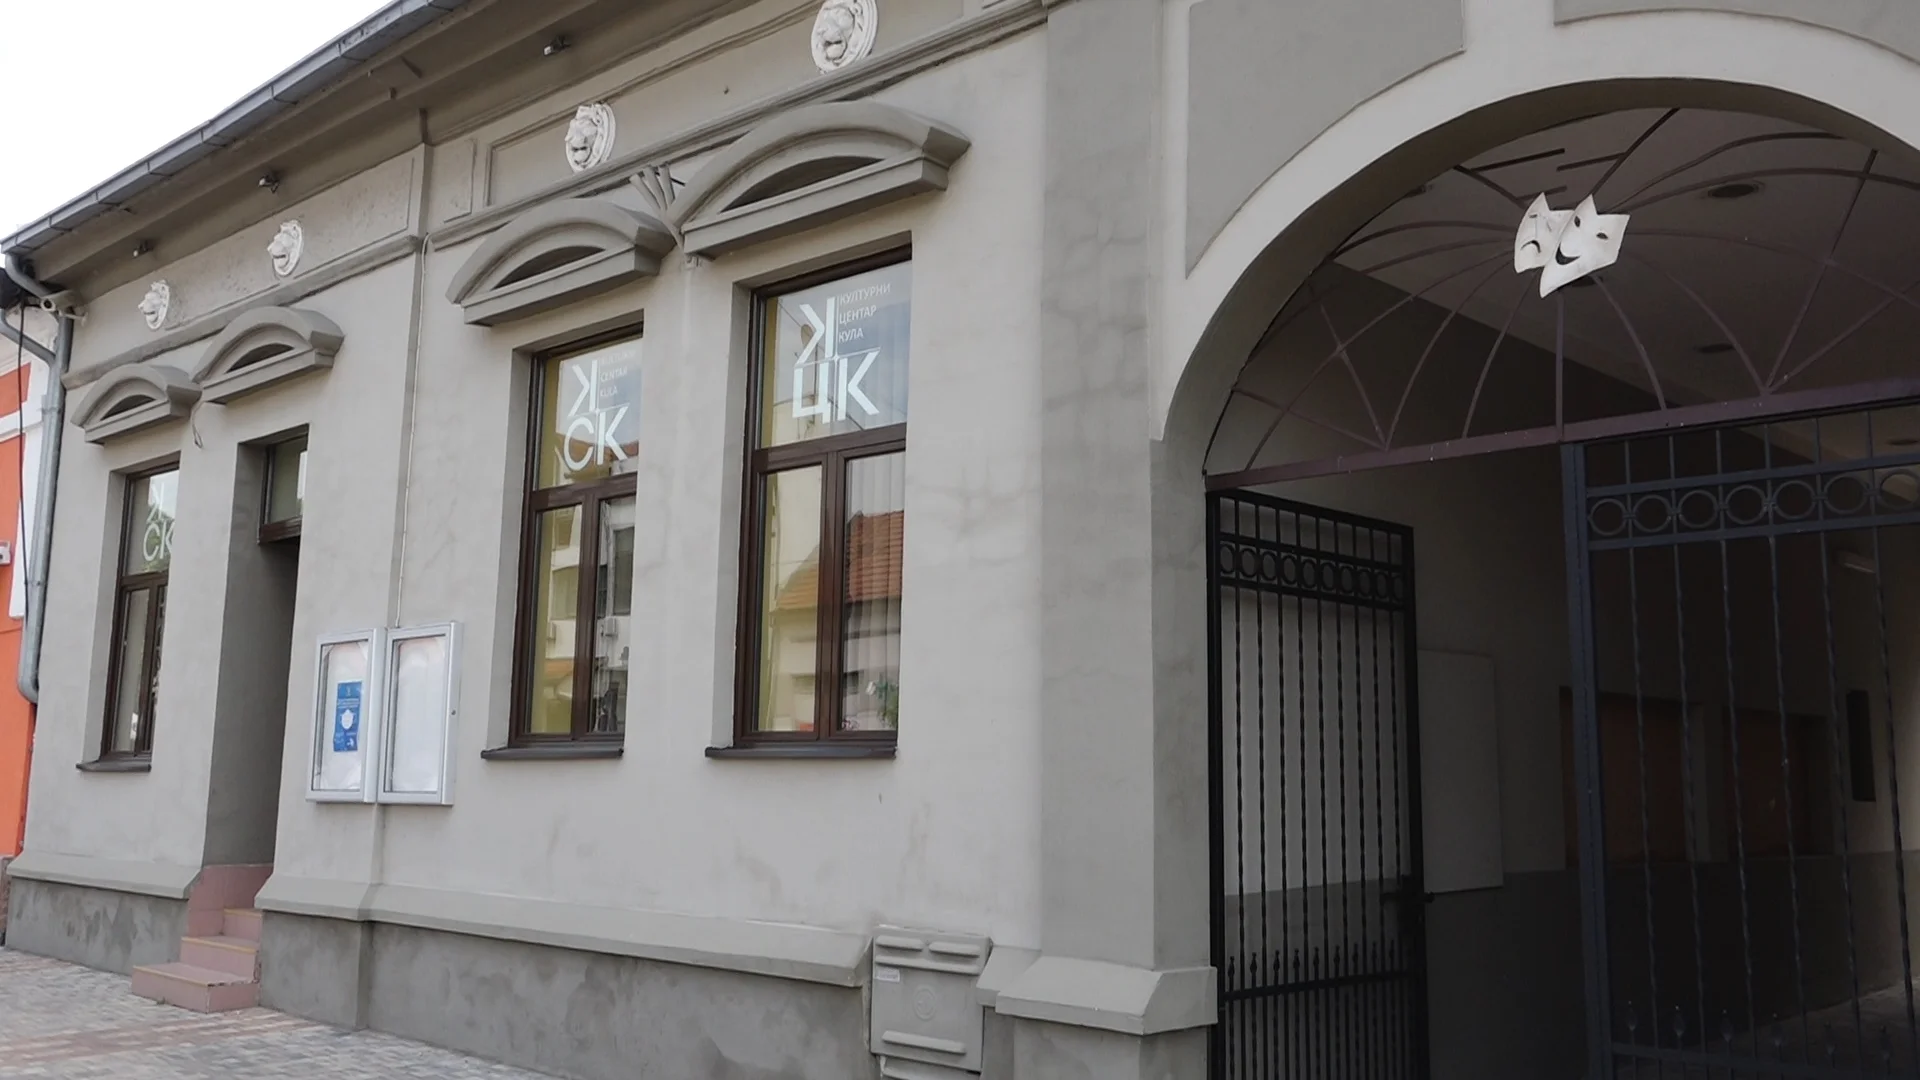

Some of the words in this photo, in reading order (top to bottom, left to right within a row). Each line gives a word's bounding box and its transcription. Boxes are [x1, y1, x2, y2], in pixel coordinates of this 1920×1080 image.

[839, 283, 891, 304] КУЛТУРНИ
[839, 305, 877, 325] ЦЕНТАР
[838, 328, 864, 343] КУЛА
